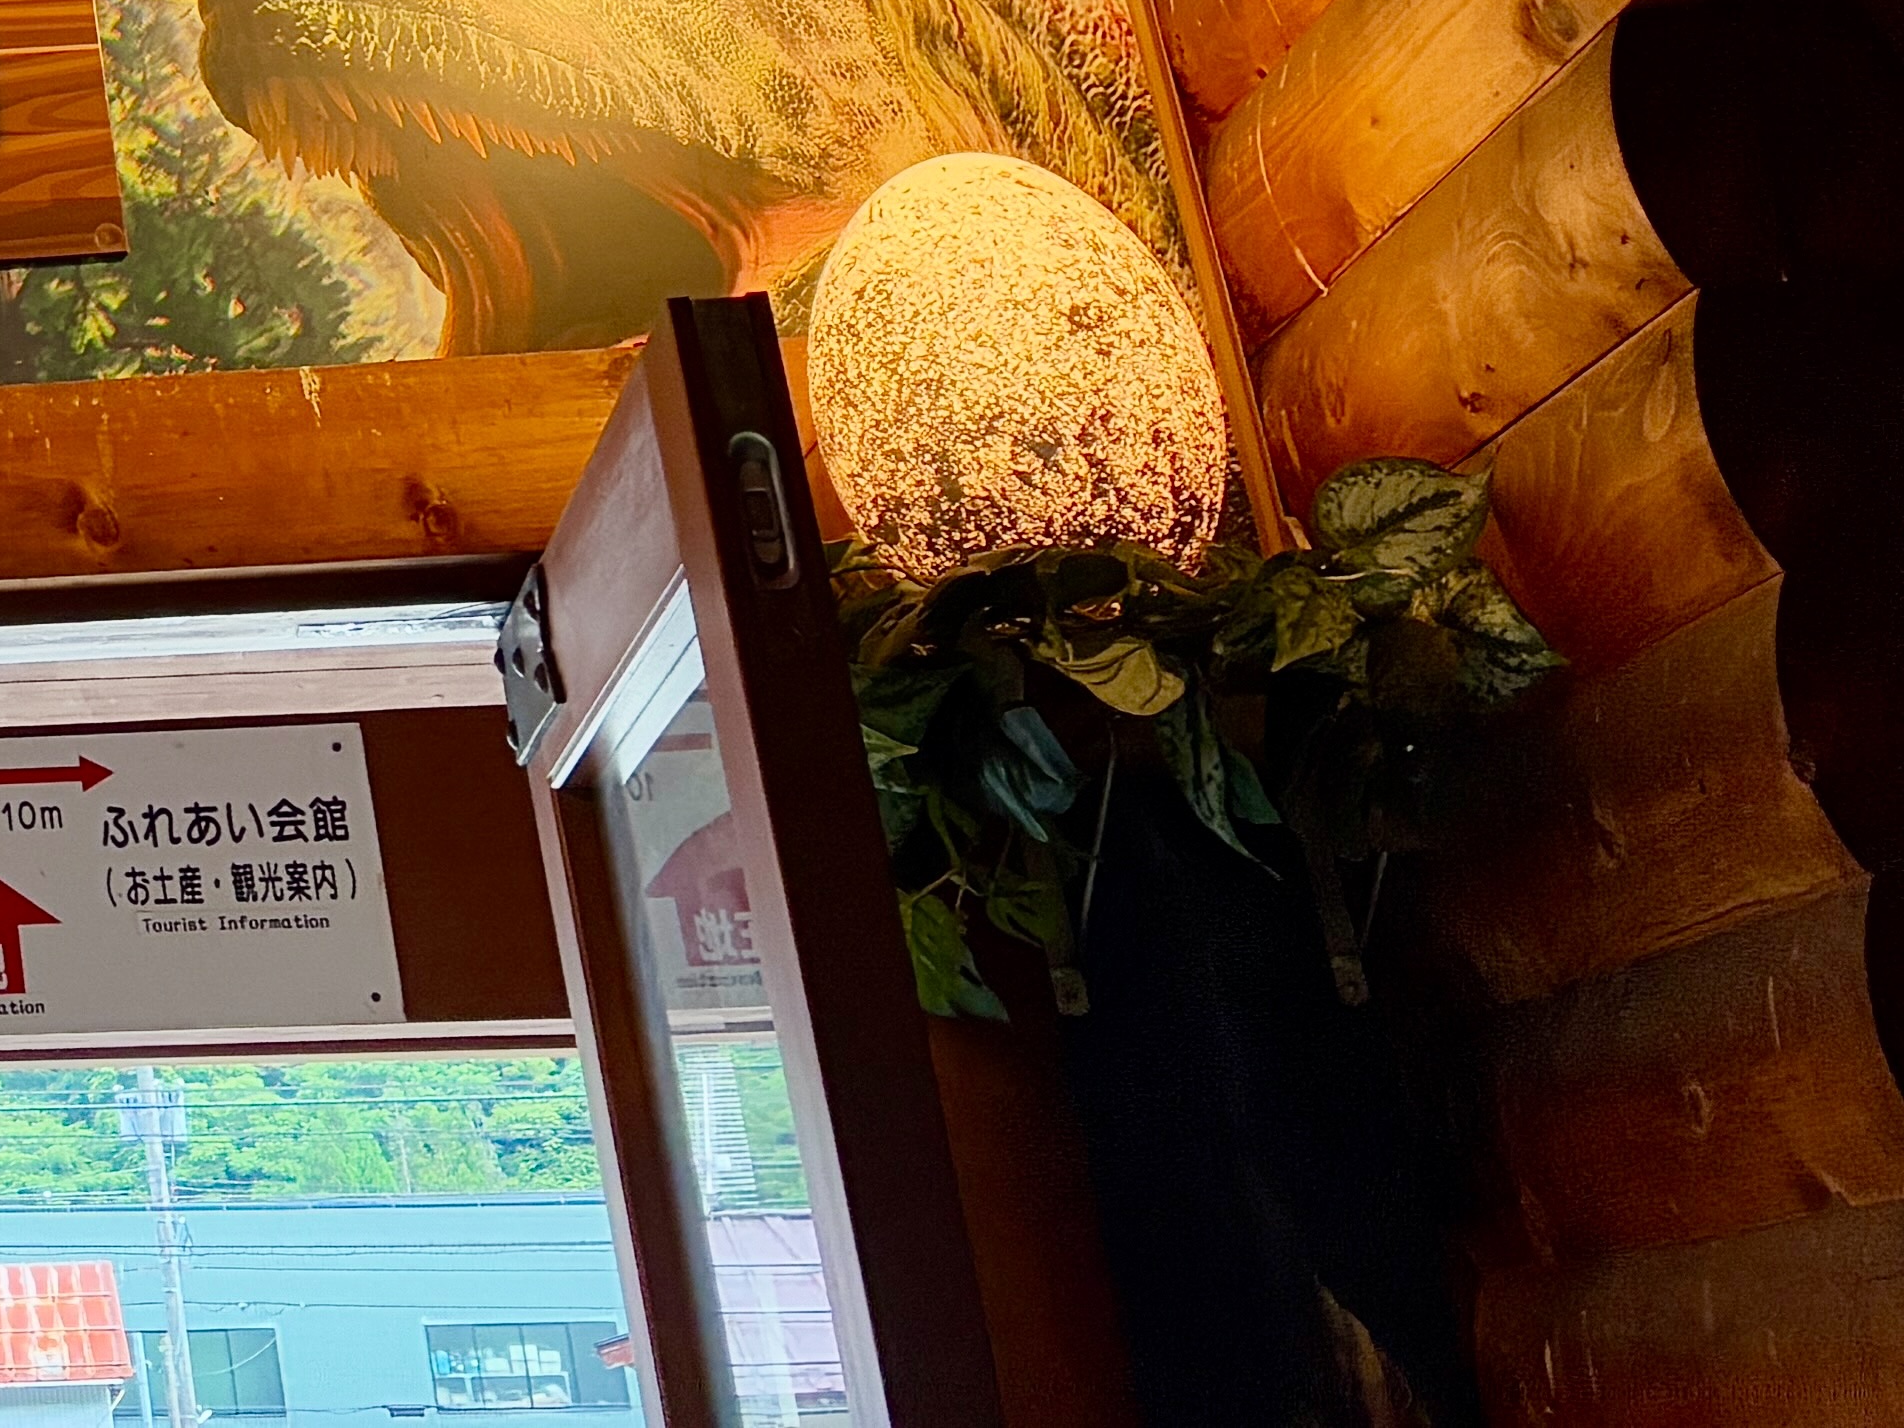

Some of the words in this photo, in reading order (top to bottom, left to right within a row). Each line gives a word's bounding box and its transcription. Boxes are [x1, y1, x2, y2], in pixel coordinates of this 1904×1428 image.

[1, 800, 63, 832] 10m
[102, 795, 350, 848] ふれあい会館
[142, 917, 208, 933] Tourist
[218, 914, 330, 931] Information
